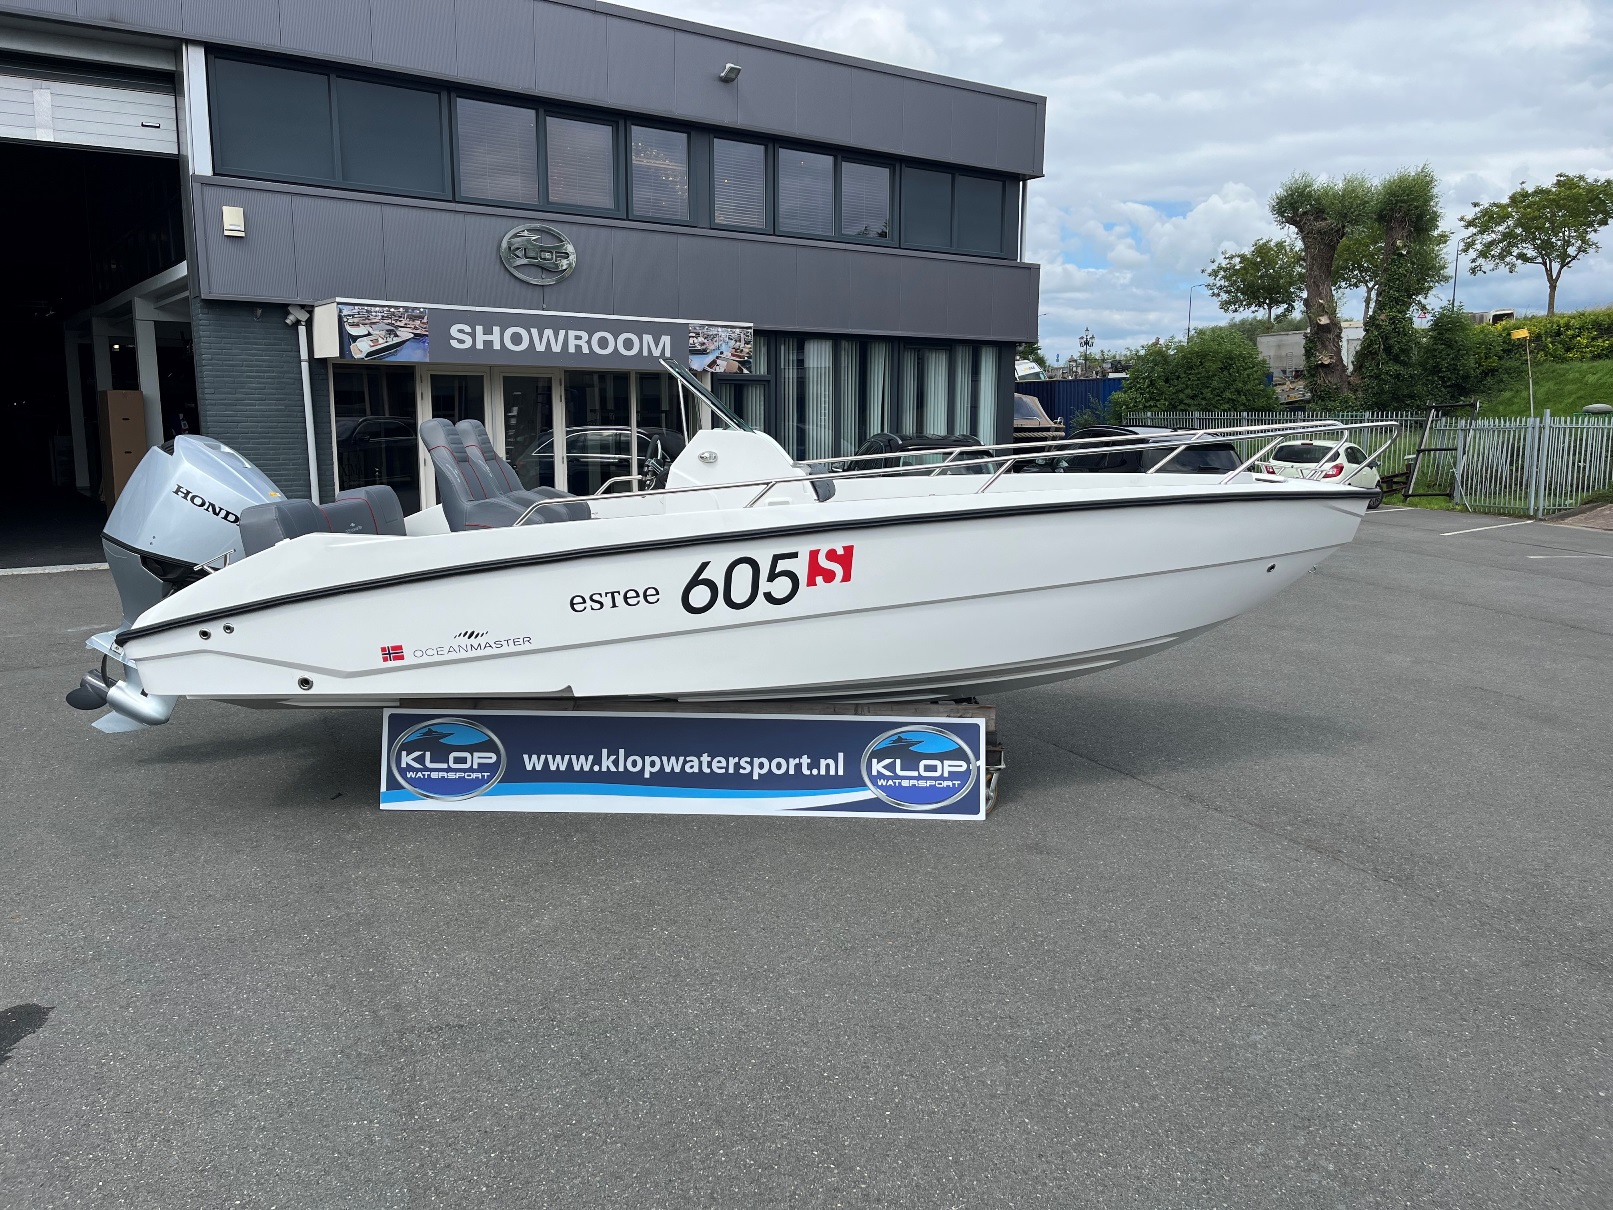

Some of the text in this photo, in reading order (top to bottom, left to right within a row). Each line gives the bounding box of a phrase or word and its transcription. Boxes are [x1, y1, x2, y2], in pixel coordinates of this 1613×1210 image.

[507, 245, 570, 263] KLOP
[450, 323, 671, 358] SHOWROOM
[172, 483, 240, 527] HOND
[412, 636, 533, 658] OCEANMASTER
[401, 750, 497, 769] KLOP
[522, 748, 844, 780] www.klopwatersport.nl
[871, 758, 968, 778] KLOP
[406, 771, 490, 780] WATERSPORT
[877, 778, 961, 788] WATERSPORT
